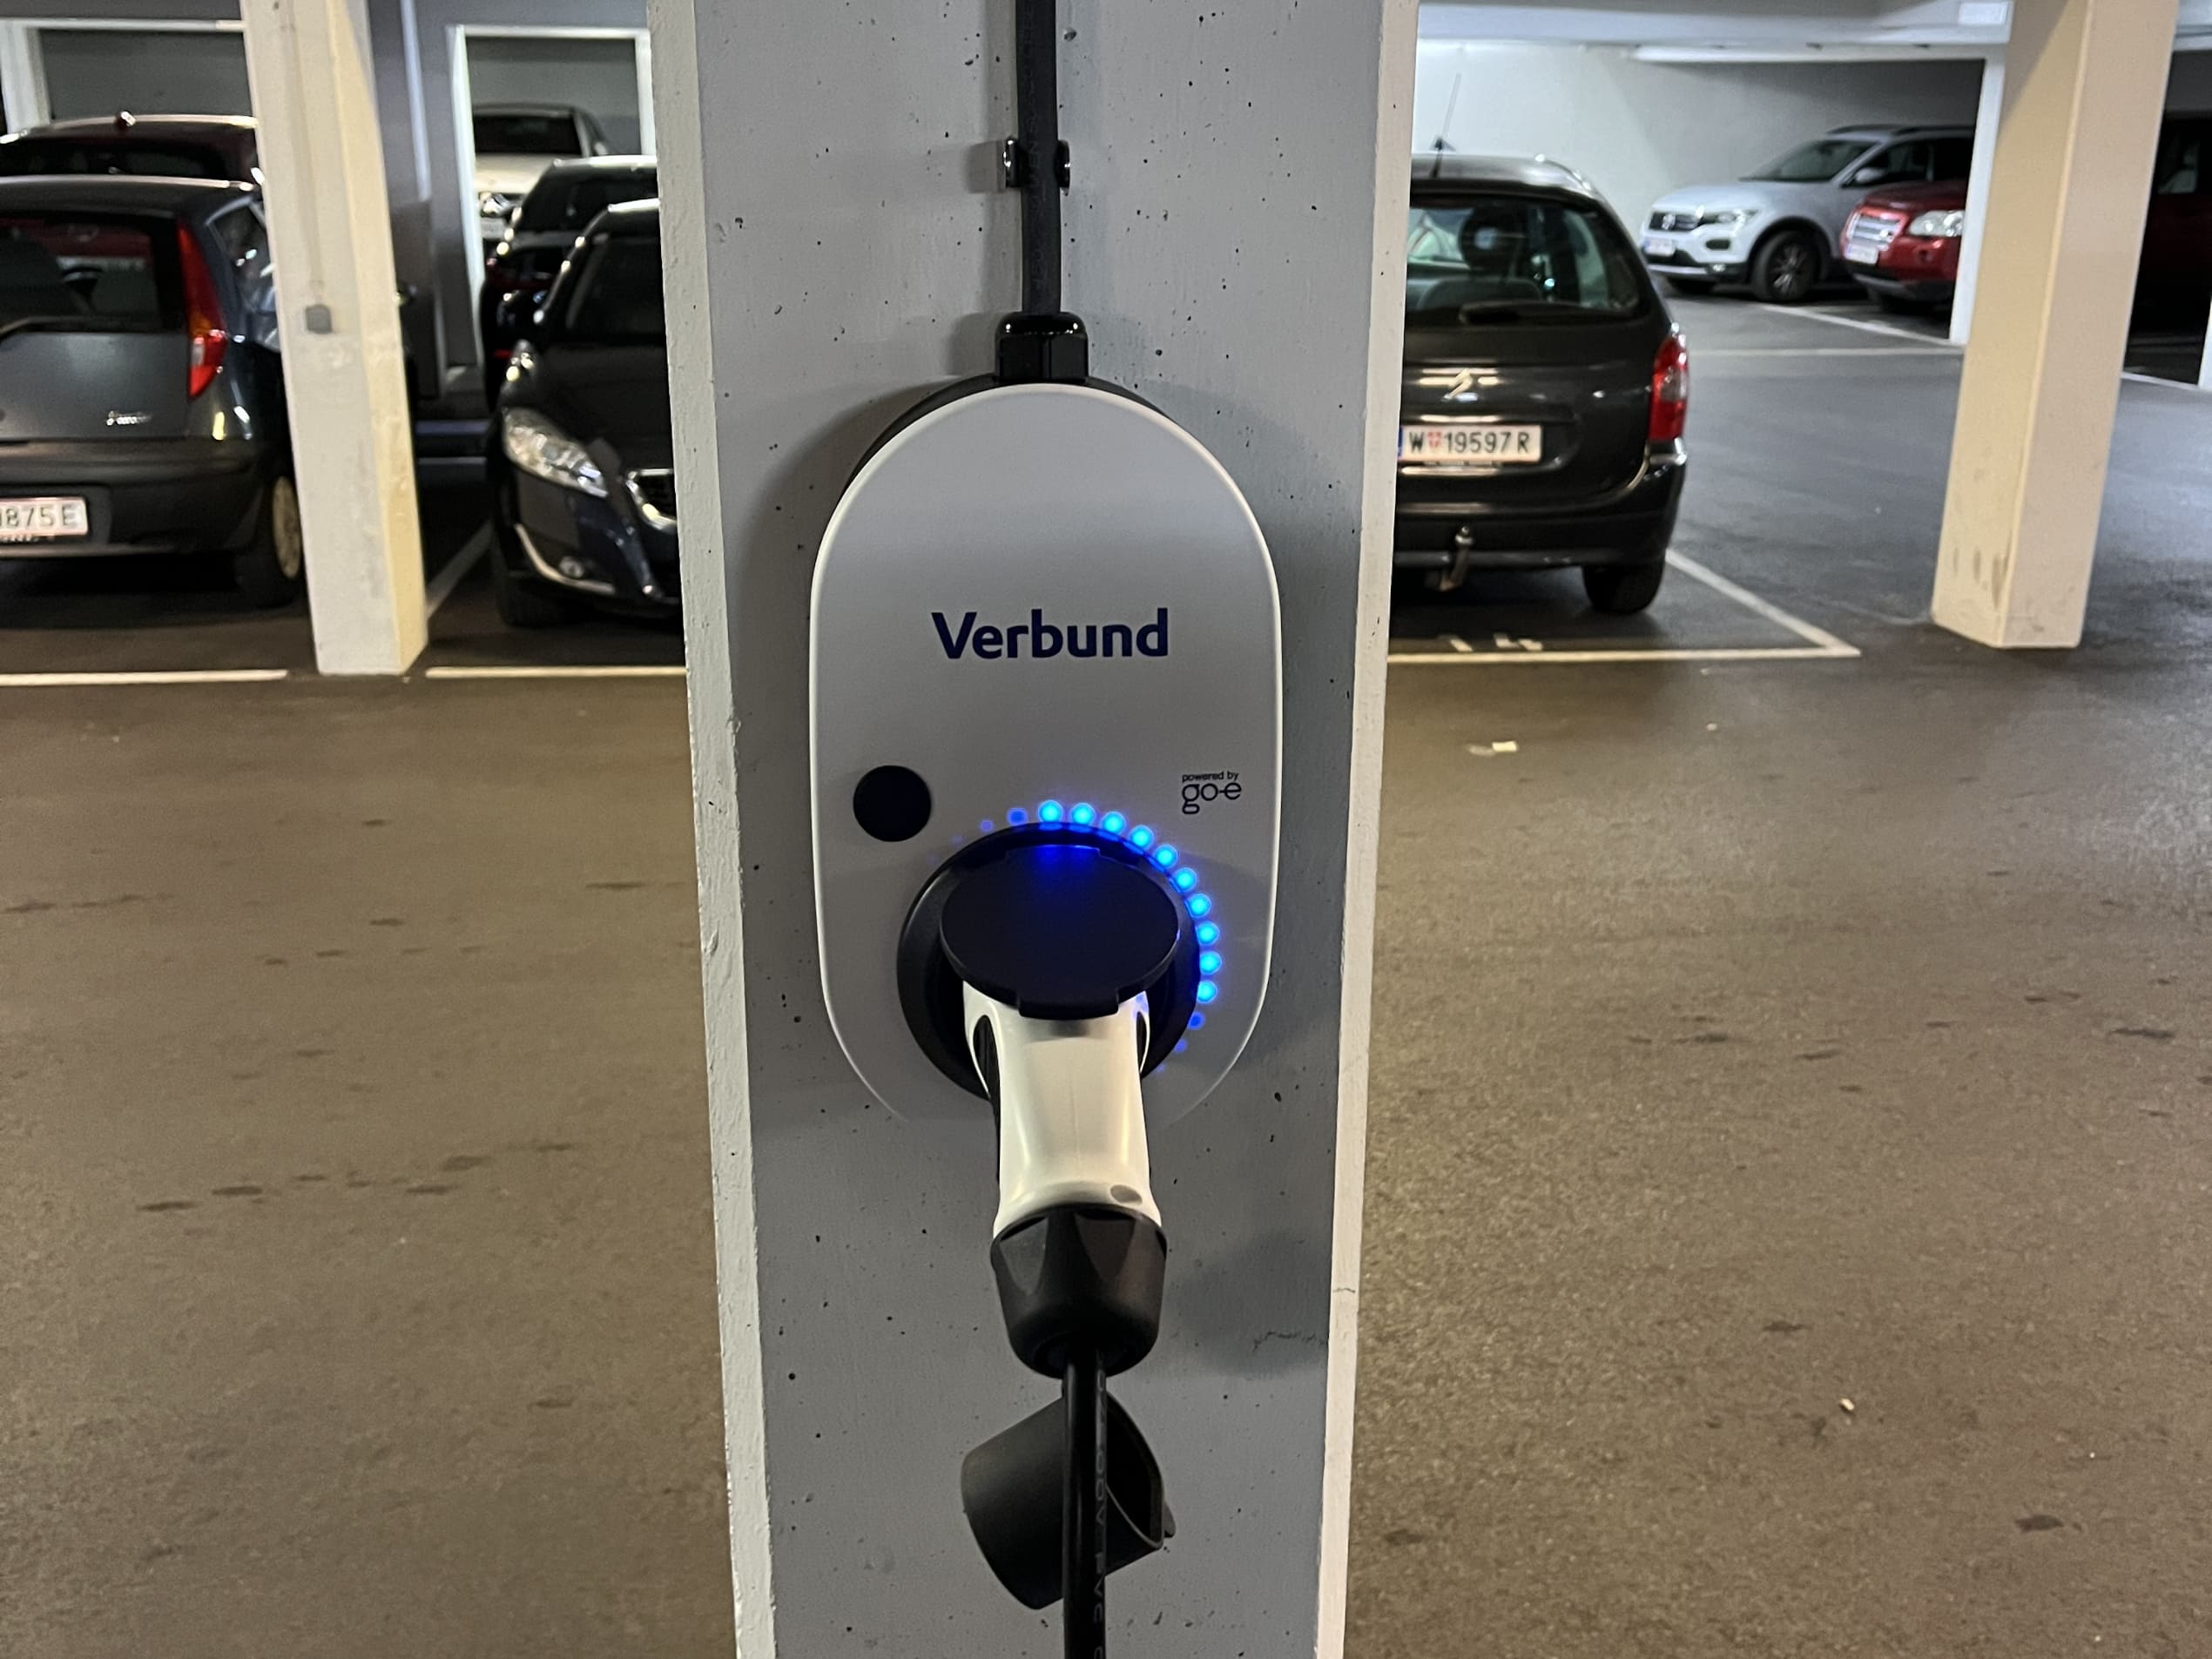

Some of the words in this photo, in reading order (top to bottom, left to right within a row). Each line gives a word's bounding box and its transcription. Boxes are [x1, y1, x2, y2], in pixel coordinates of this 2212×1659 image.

[1409, 432, 1424, 453] W
[0, 505, 55, 527] 875
[931, 607, 1169, 659] Verbund
[1182, 771, 1224, 783] powered
[1227, 771, 1239, 781] by
[1182, 782, 1242, 814] go-e
